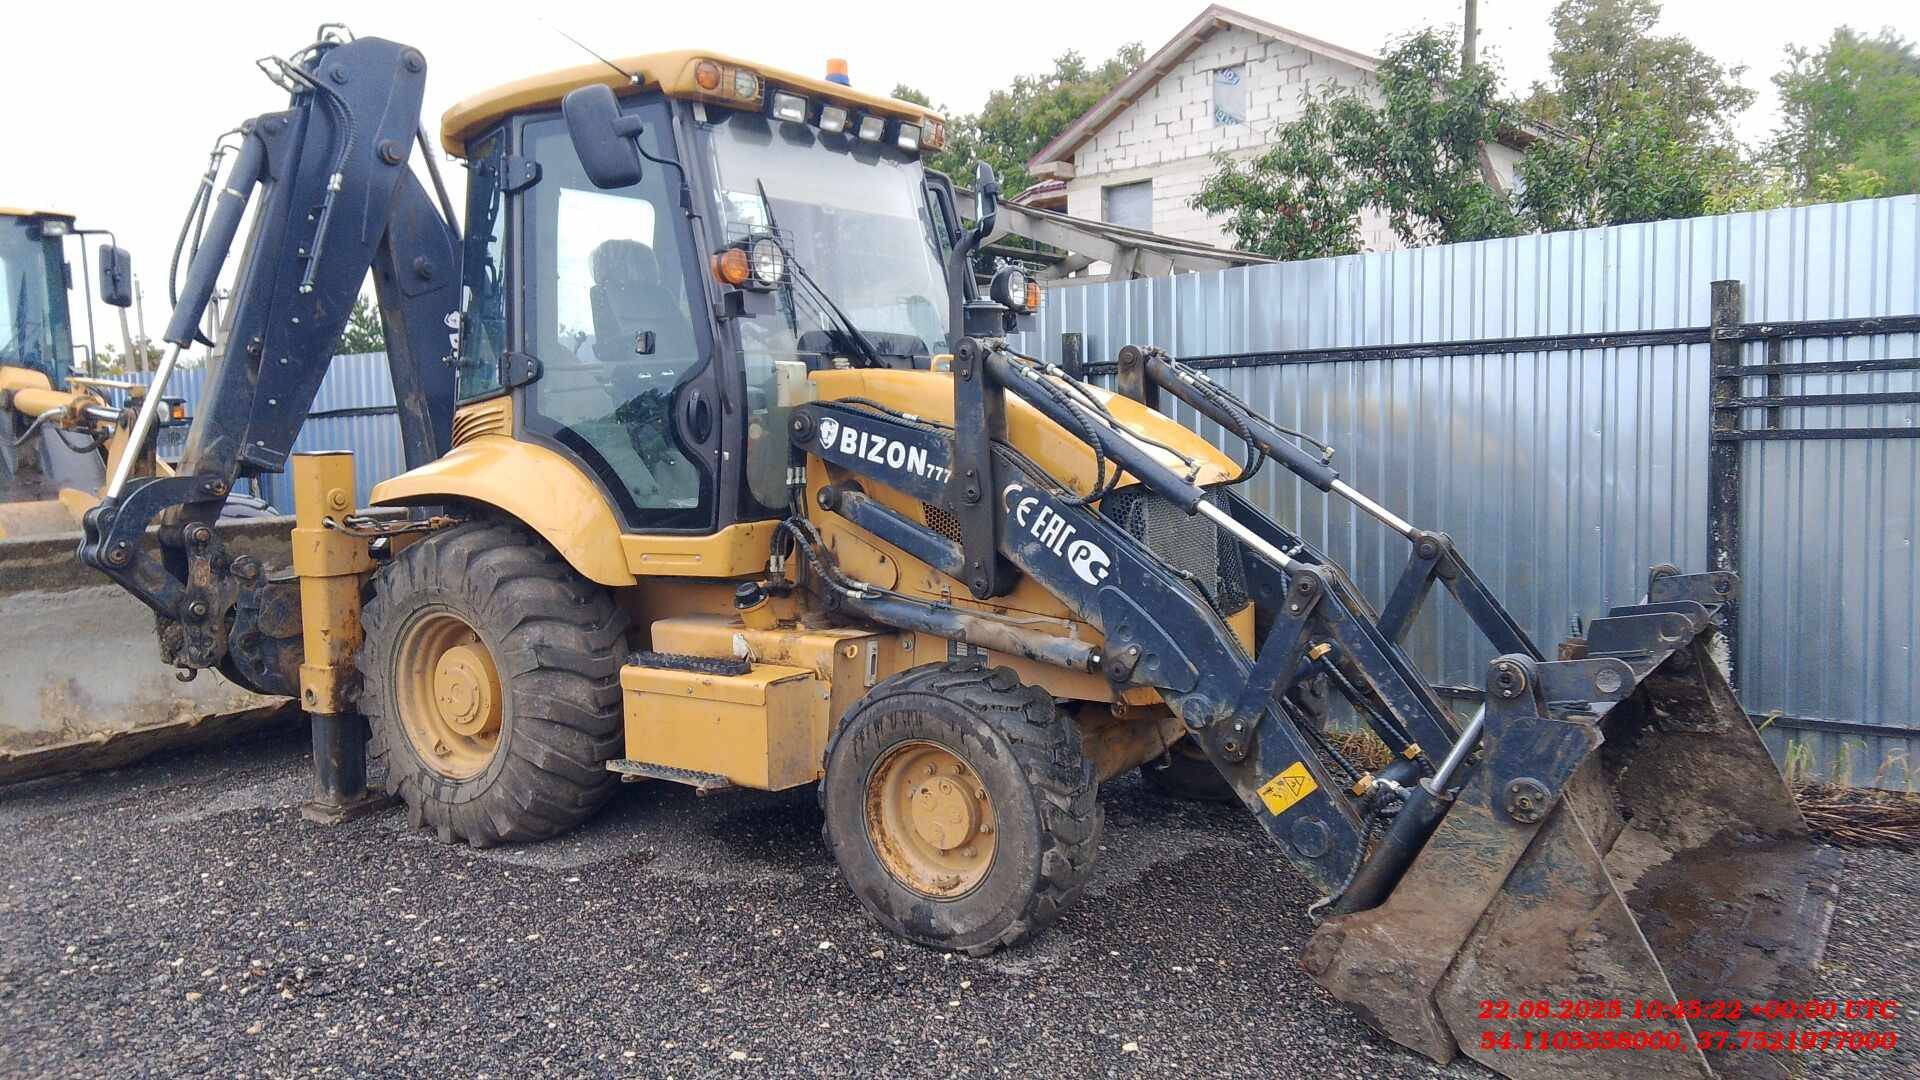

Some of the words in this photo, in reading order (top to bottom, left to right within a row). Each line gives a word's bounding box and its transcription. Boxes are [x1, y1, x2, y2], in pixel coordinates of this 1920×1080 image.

[840, 426, 928, 476] BIZON
[926, 463, 953, 484] 777
[1030, 505, 1077, 557] EAC
